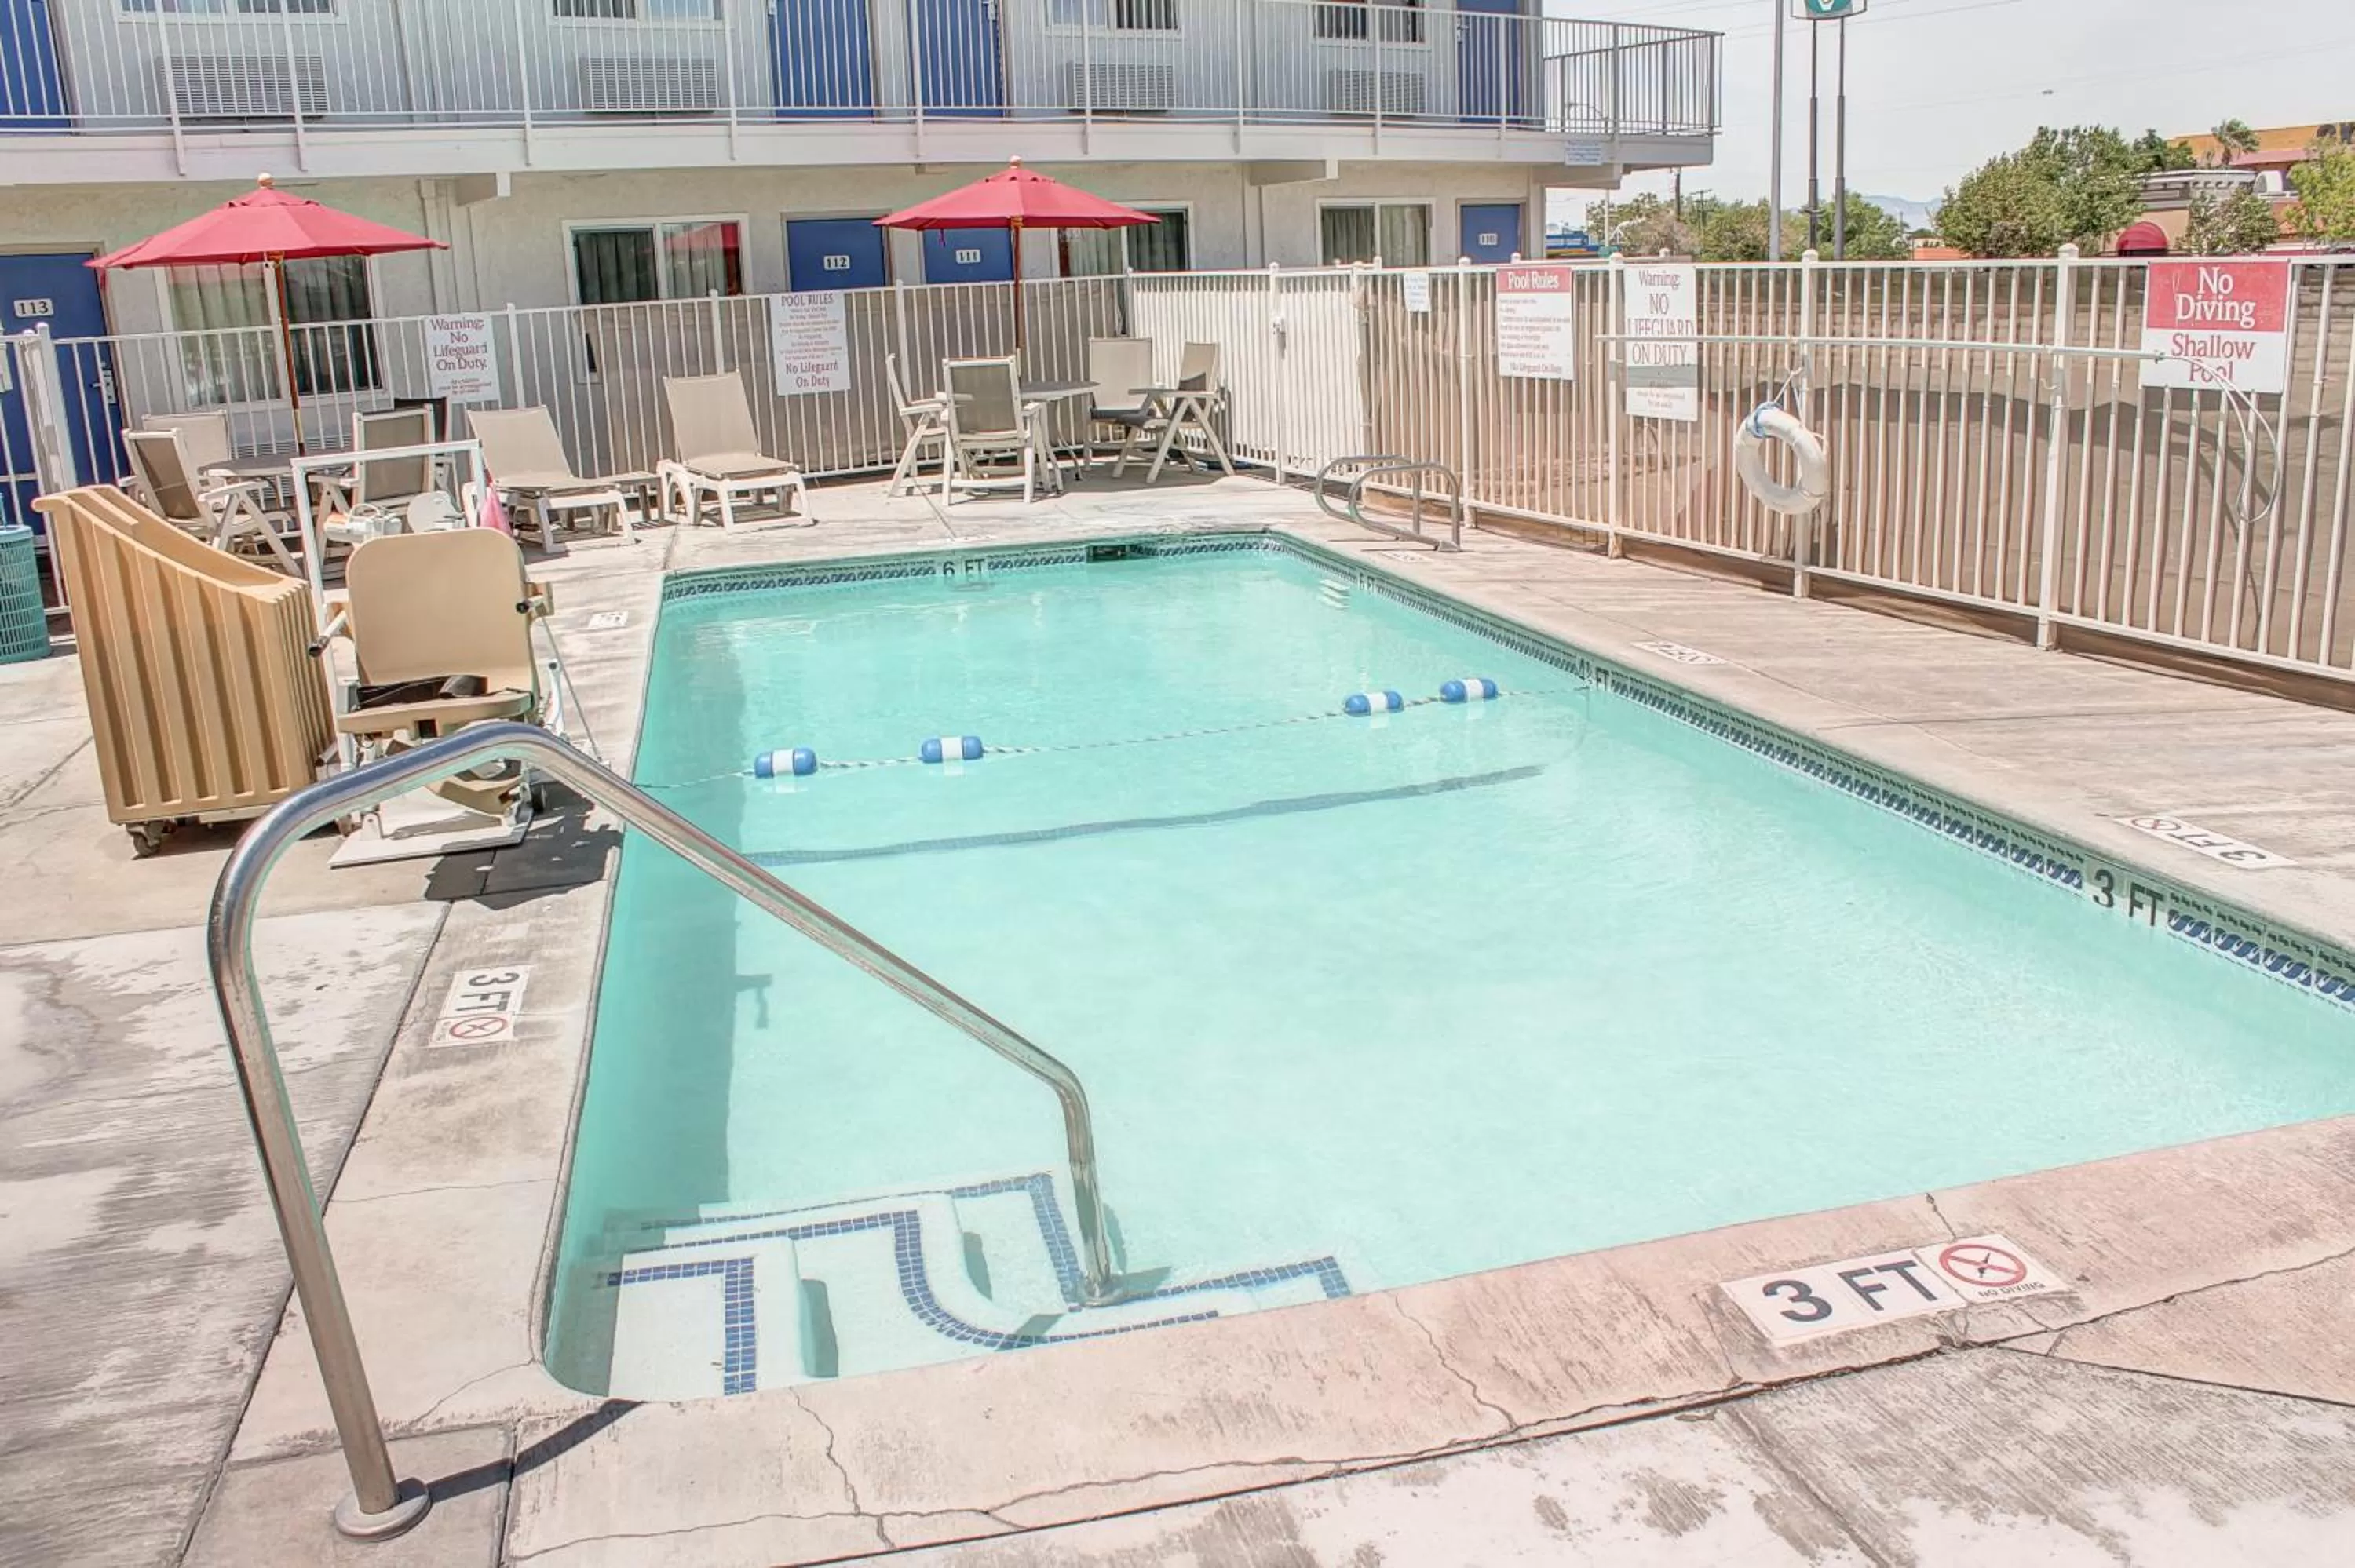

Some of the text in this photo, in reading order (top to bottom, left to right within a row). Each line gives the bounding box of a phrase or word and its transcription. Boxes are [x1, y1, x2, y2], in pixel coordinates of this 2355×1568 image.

[826, 257, 848, 268] 112
[959, 250, 978, 262] 111
[1507, 272, 1559, 290] Pool Rules
[2198, 266, 2233, 295] No
[19, 301, 49, 315] 113
[780, 293, 835, 307] POOL RULES
[1649, 293, 1670, 315] NO
[2176, 293, 2256, 329] Diving
[450, 331, 469, 344] No
[2172, 333, 2257, 359] Shallow
[433, 342, 488, 360] Lifeguard
[1632, 344, 1649, 365] ON
[436, 359, 455, 371] On
[786, 361, 838, 374] No Lifeguard
[2189, 359, 2234, 383] Pool
[795, 376, 809, 388] On
[944, 558, 985, 574] 6 FT
[1596, 666, 1610, 691] FT
[2167, 833, 2266, 861] 3 FT
[2093, 869, 2164, 926] 3 FT
[455, 973, 520, 1011] 3 FT
[1762, 1260, 1938, 1323] 3 FT
[1999, 1282, 2046, 1294] DIVING
